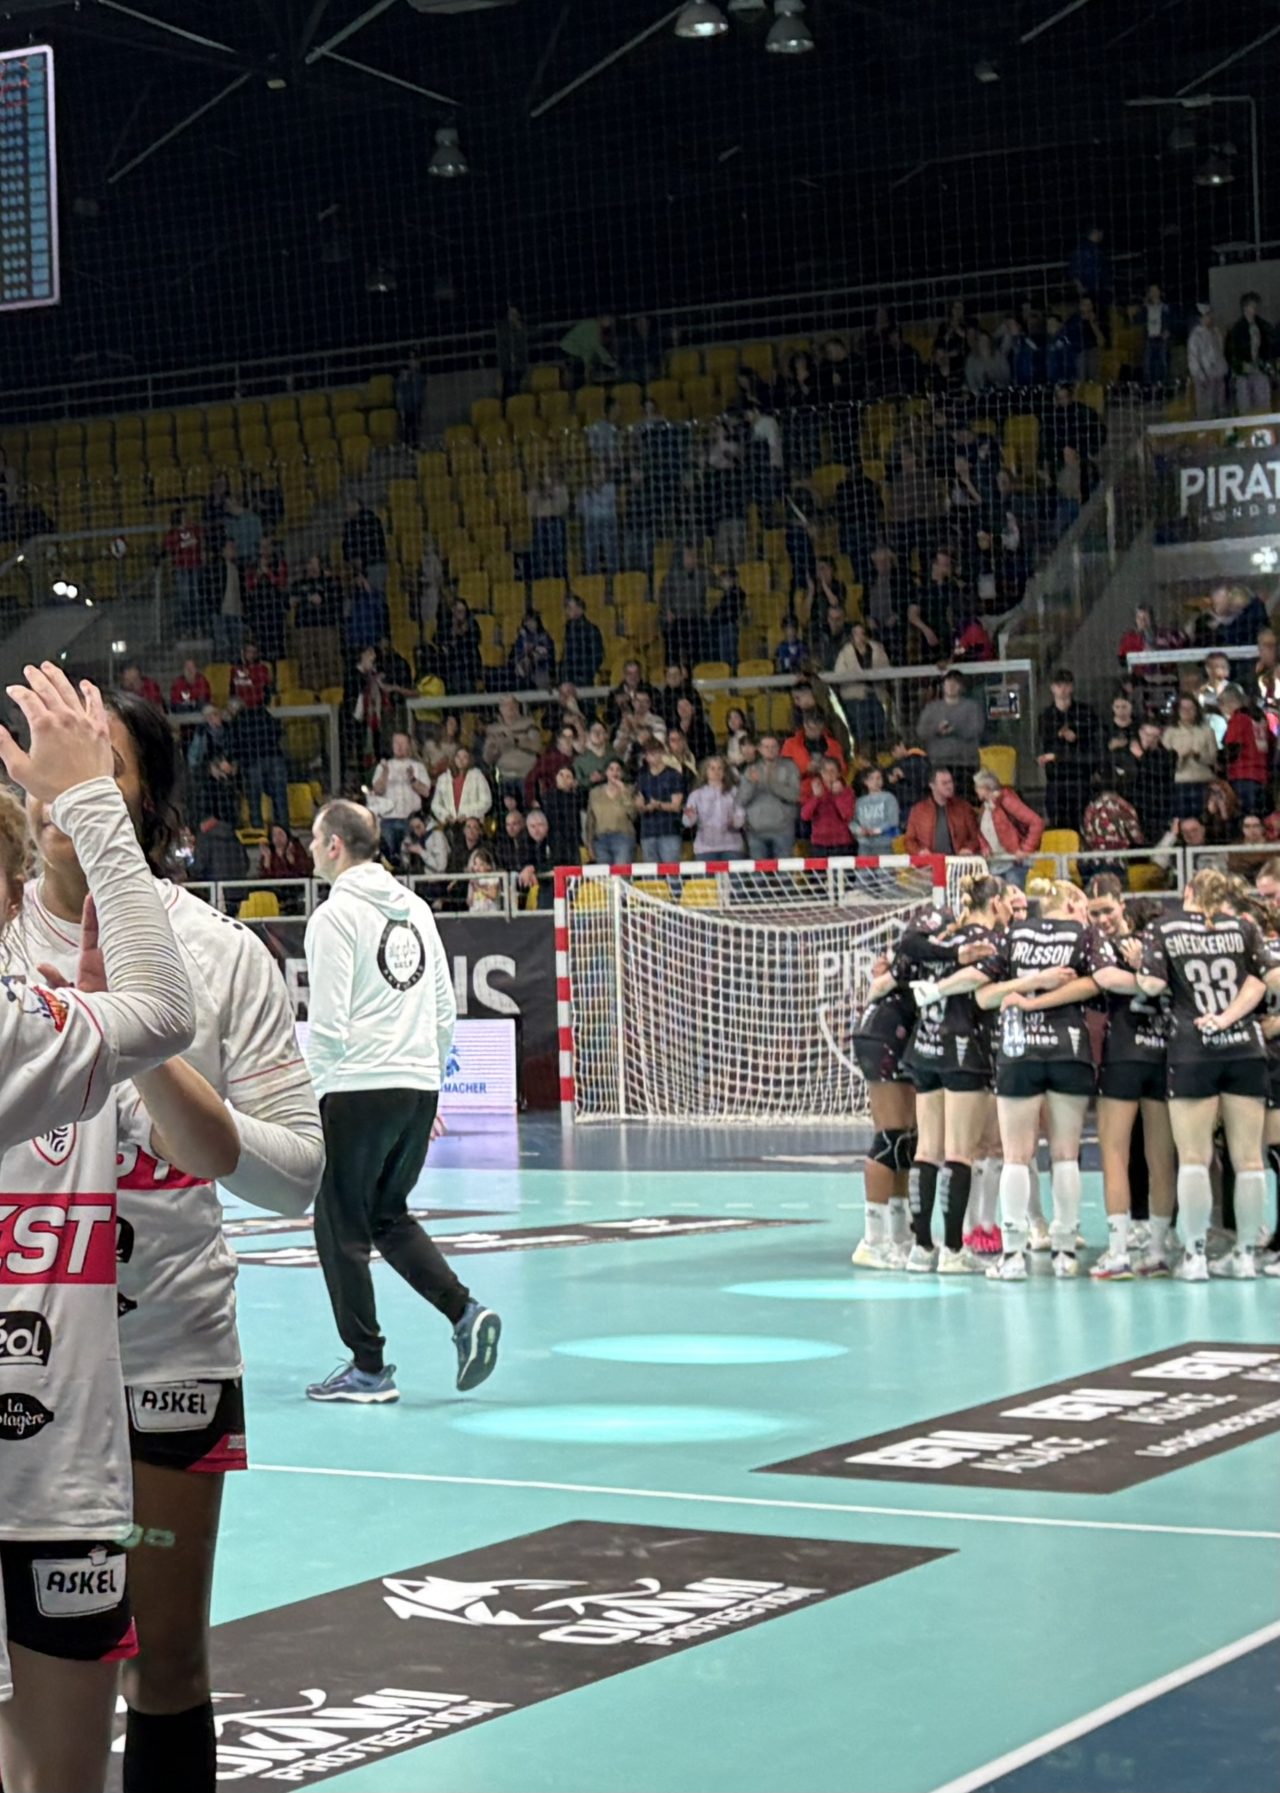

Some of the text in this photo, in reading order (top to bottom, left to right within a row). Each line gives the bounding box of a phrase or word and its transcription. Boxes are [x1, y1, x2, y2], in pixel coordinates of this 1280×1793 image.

[1184, 958, 1238, 1014] 33
[441, 1082, 487, 1094] MACHER
[141, 1391, 207, 1415] ASKEL
[47, 1568, 117, 1595] ASKEL
[258, 1699, 516, 1782] PROTECTION
